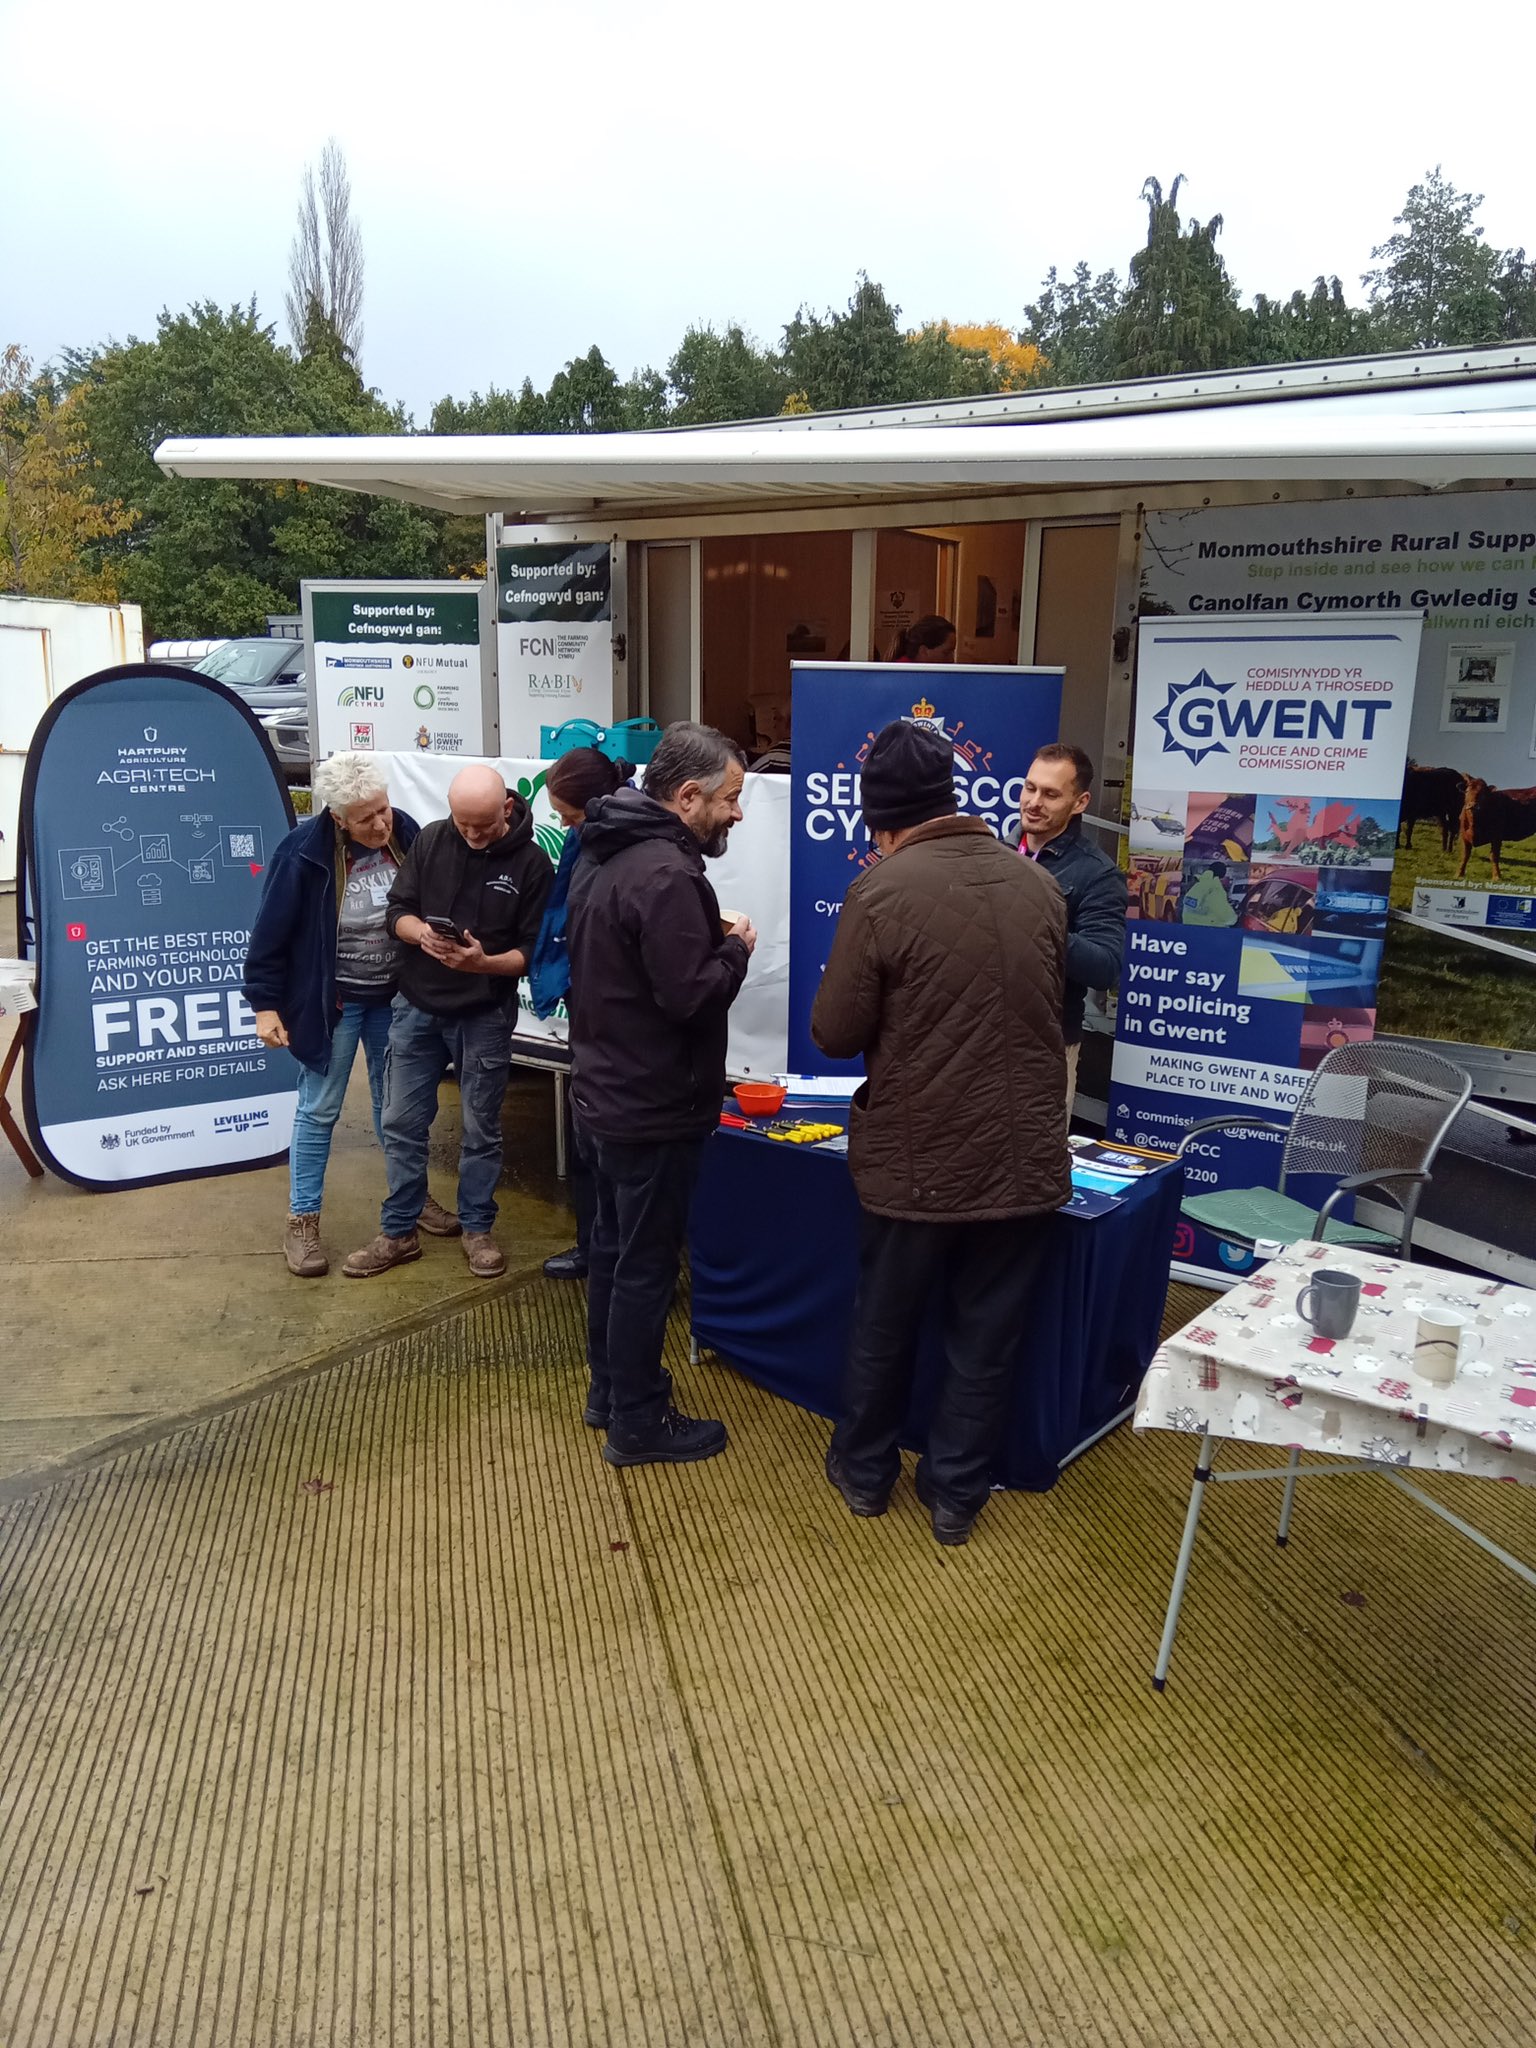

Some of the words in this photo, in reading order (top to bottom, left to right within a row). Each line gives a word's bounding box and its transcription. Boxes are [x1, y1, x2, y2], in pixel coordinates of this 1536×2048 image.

[1198, 535, 1382, 558] Monmouthshire
[1391, 532, 1460, 551] Rural
[511, 562, 573, 580] Supported
[577, 562, 596, 578] by:
[1248, 564, 1283, 580] Step
[1288, 562, 1338, 576] inside
[1344, 561, 1375, 575] and
[1381, 562, 1411, 574] see
[1417, 558, 1455, 573] how
[1457, 560, 1486, 572] we
[1491, 558, 1525, 571] can
[506, 588, 571, 606] Cefnogwyd
[576, 590, 604, 606] gan:
[1188, 593, 1289, 611] Canolfan
[1297, 590, 1401, 612] Cymorth
[1410, 588, 1518, 610] Gwledig
[353, 604, 414, 618] Supported
[417, 605, 435, 618] by:
[348, 623, 413, 637] Cefnogwyd
[416, 625, 442, 637] gan:
[1474, 614, 1489, 629] ni
[1496, 613, 1533, 629] eich
[520, 638, 554, 656] FCN
[416, 658, 433, 667] NFU
[436, 658, 468, 669] Mutual
[1247, 668, 1340, 678] COMISIYNYDD
[1344, 668, 1362, 678] YR
[354, 686, 384, 700] NFU
[1246, 681, 1299, 691] HEDDLU
[1301, 681, 1312, 691] A
[1316, 681, 1394, 692] THROSEDD
[1179, 697, 1393, 740] GWENT
[437, 738, 463, 746] GWENT
[118, 747, 187, 756] HARTPURY
[1240, 745, 1287, 757] POLICE
[1290, 746, 1320, 757] AND
[1323, 747, 1368, 759] CRIME
[1238, 758, 1345, 771] COMMISSIONER
[129, 785, 186, 793] CENTRE
[1416, 877, 1466, 888] Sponsored
[1468, 879, 1482, 888] by:
[86, 939, 120, 955] GET
[124, 936, 159, 952] THE
[164, 932, 207, 949] BEST
[1131, 932, 1187, 955] Have
[87, 954, 157, 972] FARMING
[160, 947, 249, 965] TECHNOLOG
[90, 973, 137, 994] AND
[143, 967, 202, 988] YOUR
[1128, 963, 1179, 982] your
[1185, 971, 1226, 992] say
[1127, 990, 1151, 1007] on
[1158, 994, 1251, 1024] policing
[92, 990, 257, 1052] FREE
[1125, 1014, 1142, 1033] in
[1149, 1018, 1227, 1044] Gwent
[96, 1049, 164, 1068] SUPPORT
[166, 1045, 196, 1059] AND
[199, 1038, 265, 1055] SERVICES
[97, 1076, 128, 1092] ASK
[132, 1070, 172, 1087] HERE
[176, 1066, 204, 1081] FOR
[209, 1059, 266, 1077] DETAILS
[1150, 1055, 1204, 1072] MAKING
[1208, 1063, 1257, 1083] GWENT
[1260, 1071, 1269, 1083] A
[1146, 1072, 1184, 1087] PLACE
[1188, 1077, 1206, 1090] TO
[1210, 1081, 1236, 1096] LIVE
[1240, 1086, 1269, 1100] AND
[214, 1110, 269, 1126] LEVELLING
[124, 1125, 158, 1138] Funded
[160, 1124, 171, 1133] by
[235, 1123, 250, 1132] UP
[125, 1137, 140, 1147] UK
[142, 1129, 195, 1144] Government
